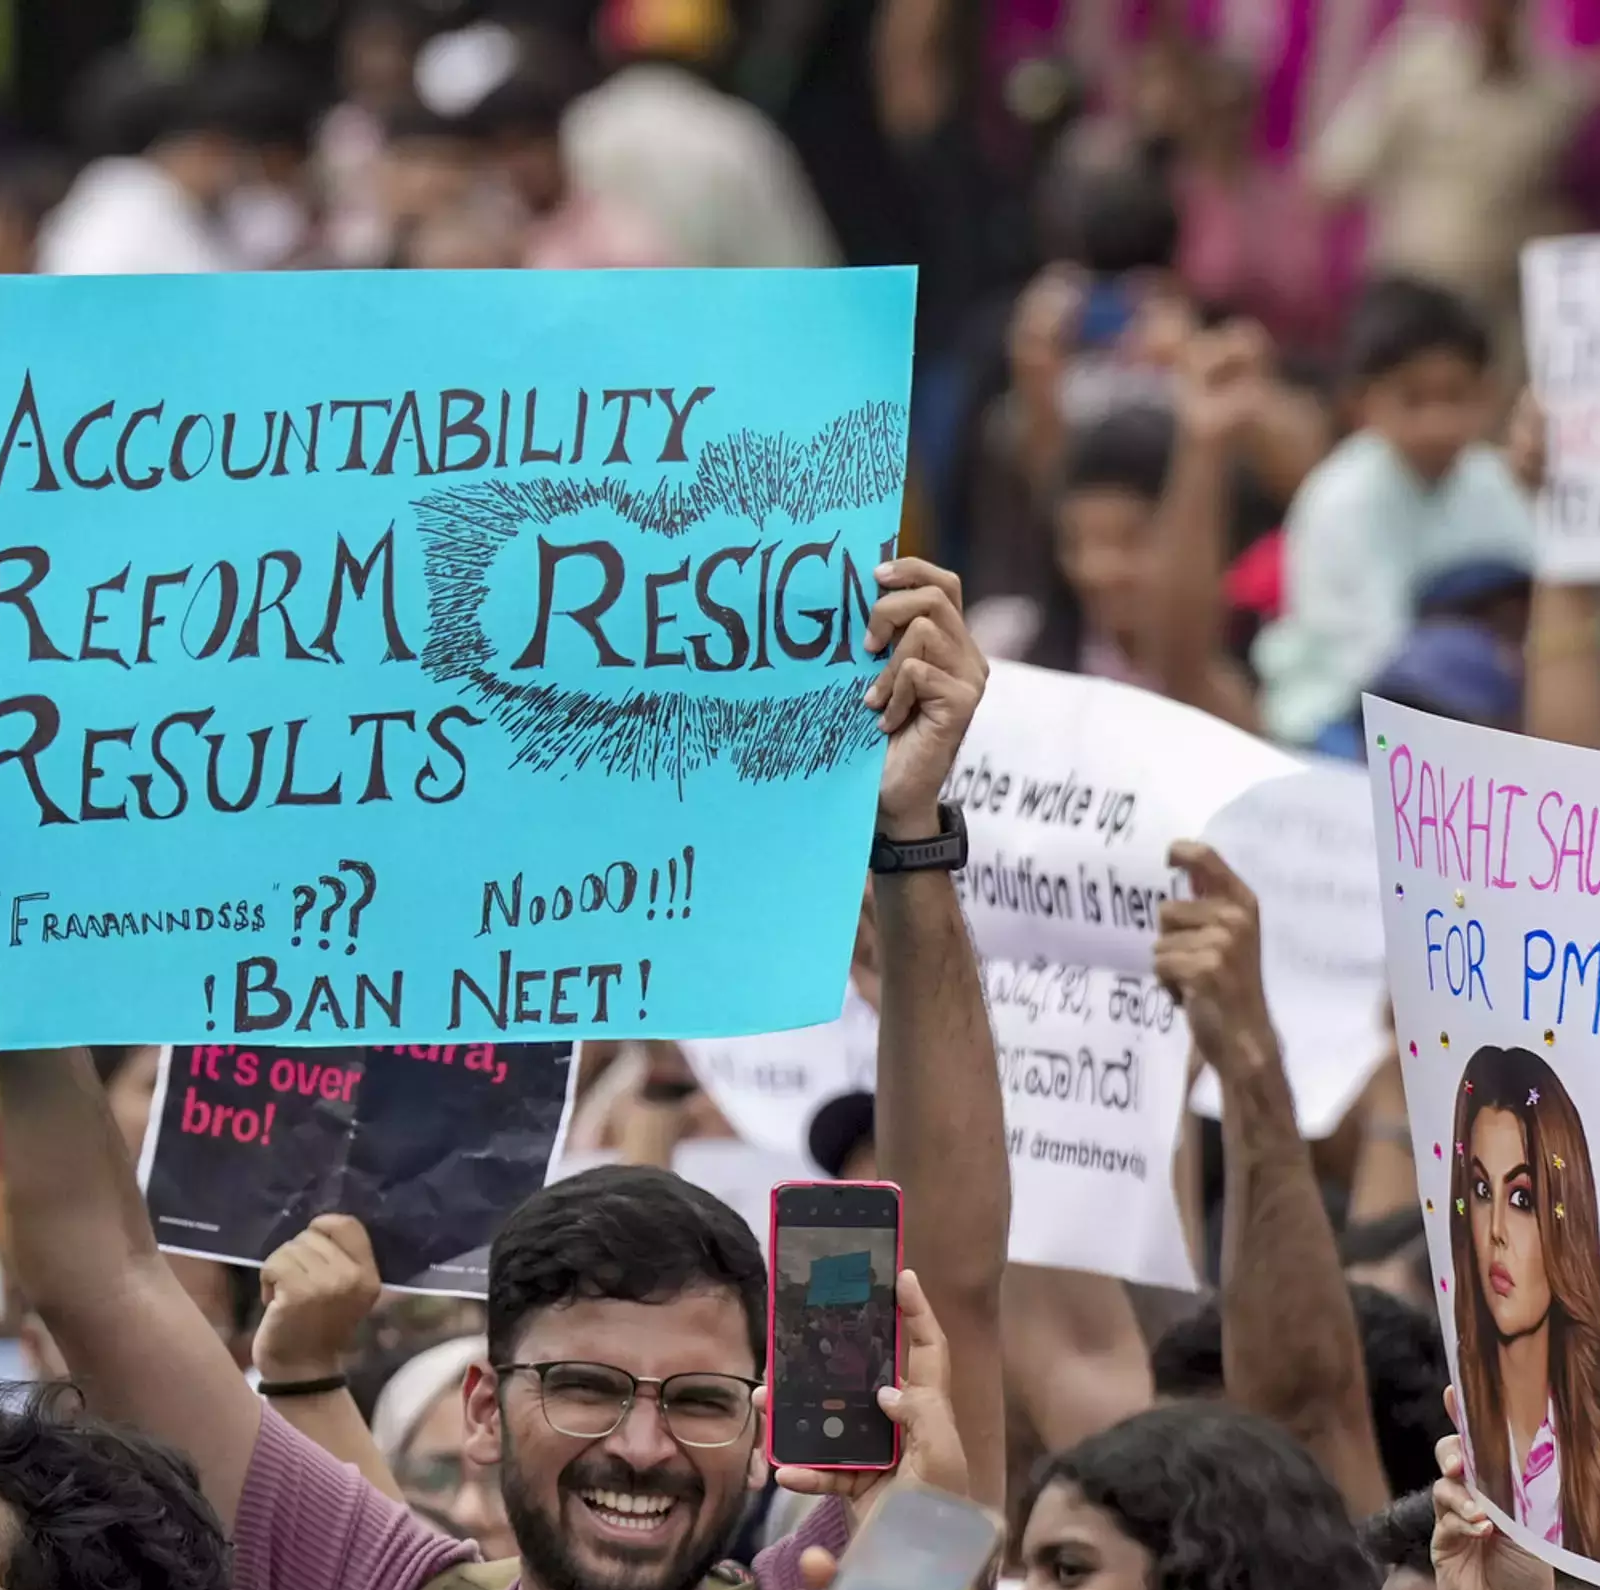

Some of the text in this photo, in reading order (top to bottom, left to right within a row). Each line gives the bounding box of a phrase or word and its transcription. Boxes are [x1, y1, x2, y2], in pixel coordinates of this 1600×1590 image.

[1015, 768, 1093, 827] wake
[1388, 743, 1528, 889] RAKHI
[449, 950, 652, 1031] NEET!
[1424, 908, 1494, 1011] FOR
[269, 1057, 362, 1102] over
[181, 1086, 277, 1146] bro!
